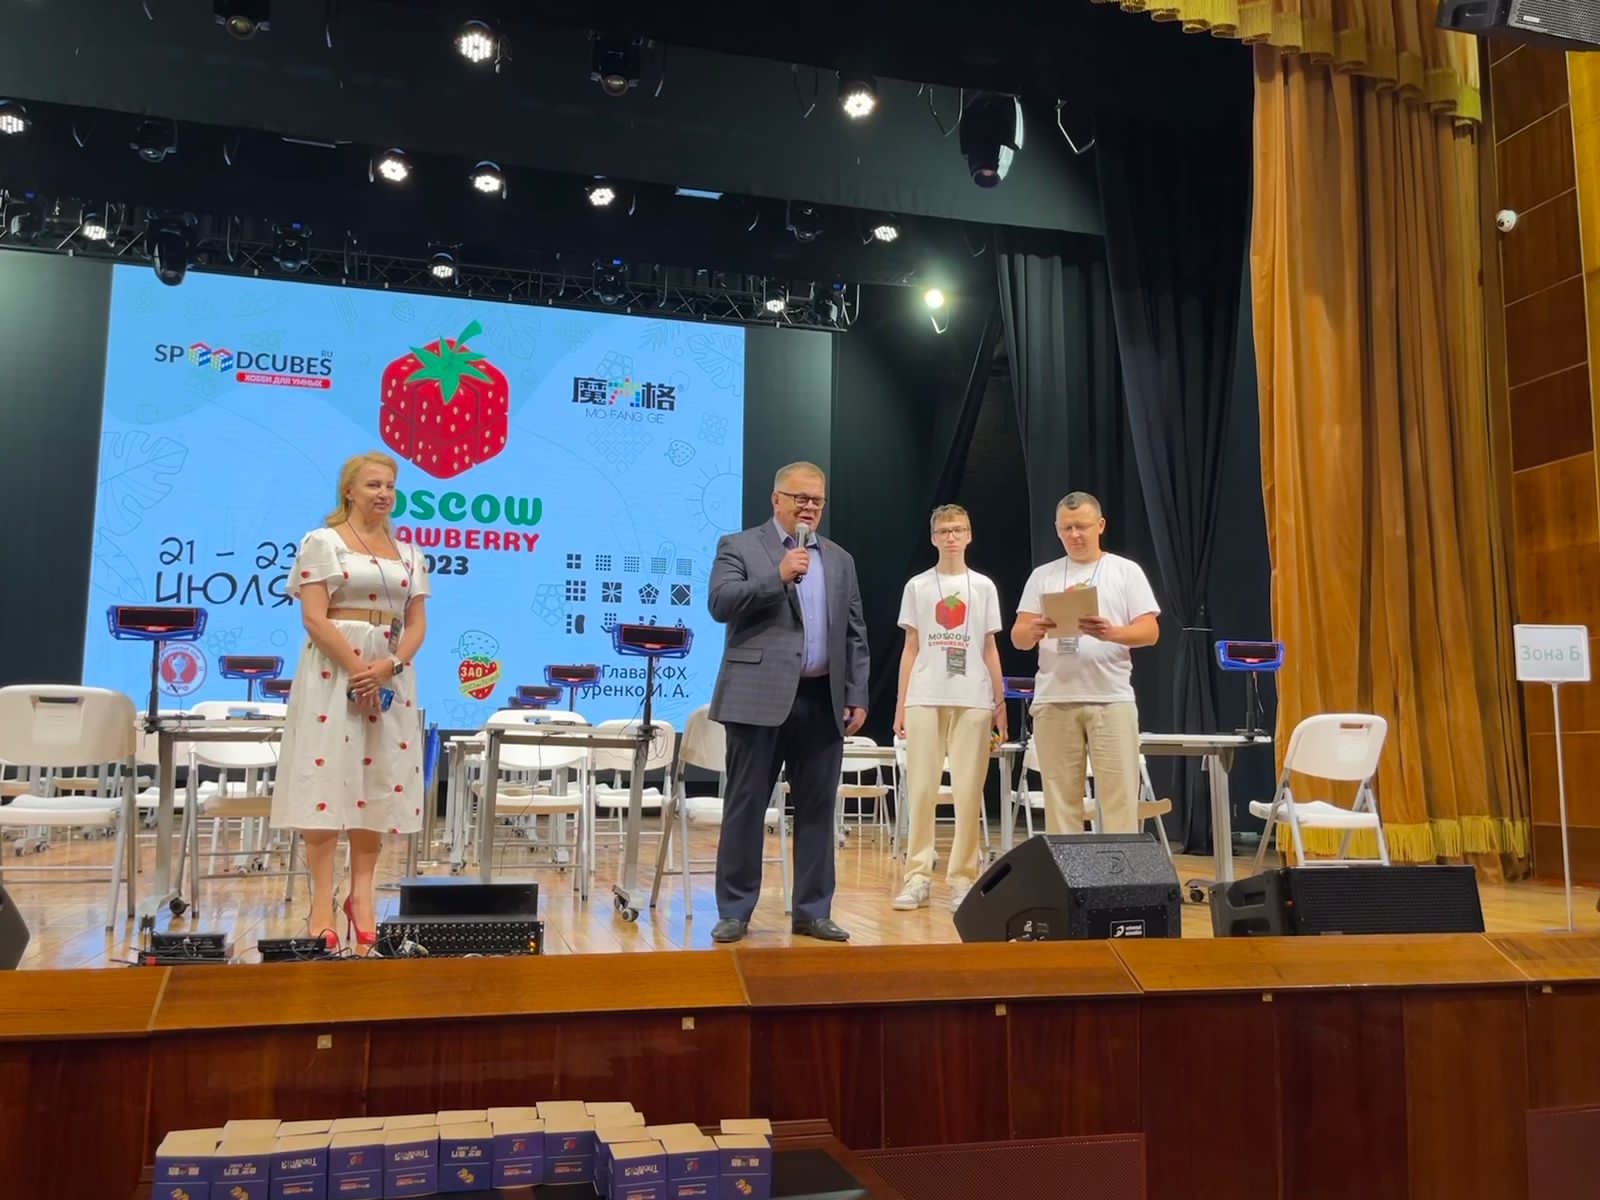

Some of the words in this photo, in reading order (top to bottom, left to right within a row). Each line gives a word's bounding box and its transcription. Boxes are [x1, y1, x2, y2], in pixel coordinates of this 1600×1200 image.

[585, 408, 607, 418] MO
[610, 409, 642, 422] FANG
[647, 412, 665, 424] GE
[390, 489, 543, 526] OSCOW
[395, 526, 540, 552] AWBERRY
[159, 537, 195, 565] 21
[424, 553, 469, 575] 023
[155, 571, 294, 609] ИЮЛЯ
[1520, 645, 1564, 661] Зона
[1569, 646, 1581, 661] Б
[602, 664, 647, 679] Глава
[578, 683, 645, 700] уренко
[671, 684, 689, 698] А.
